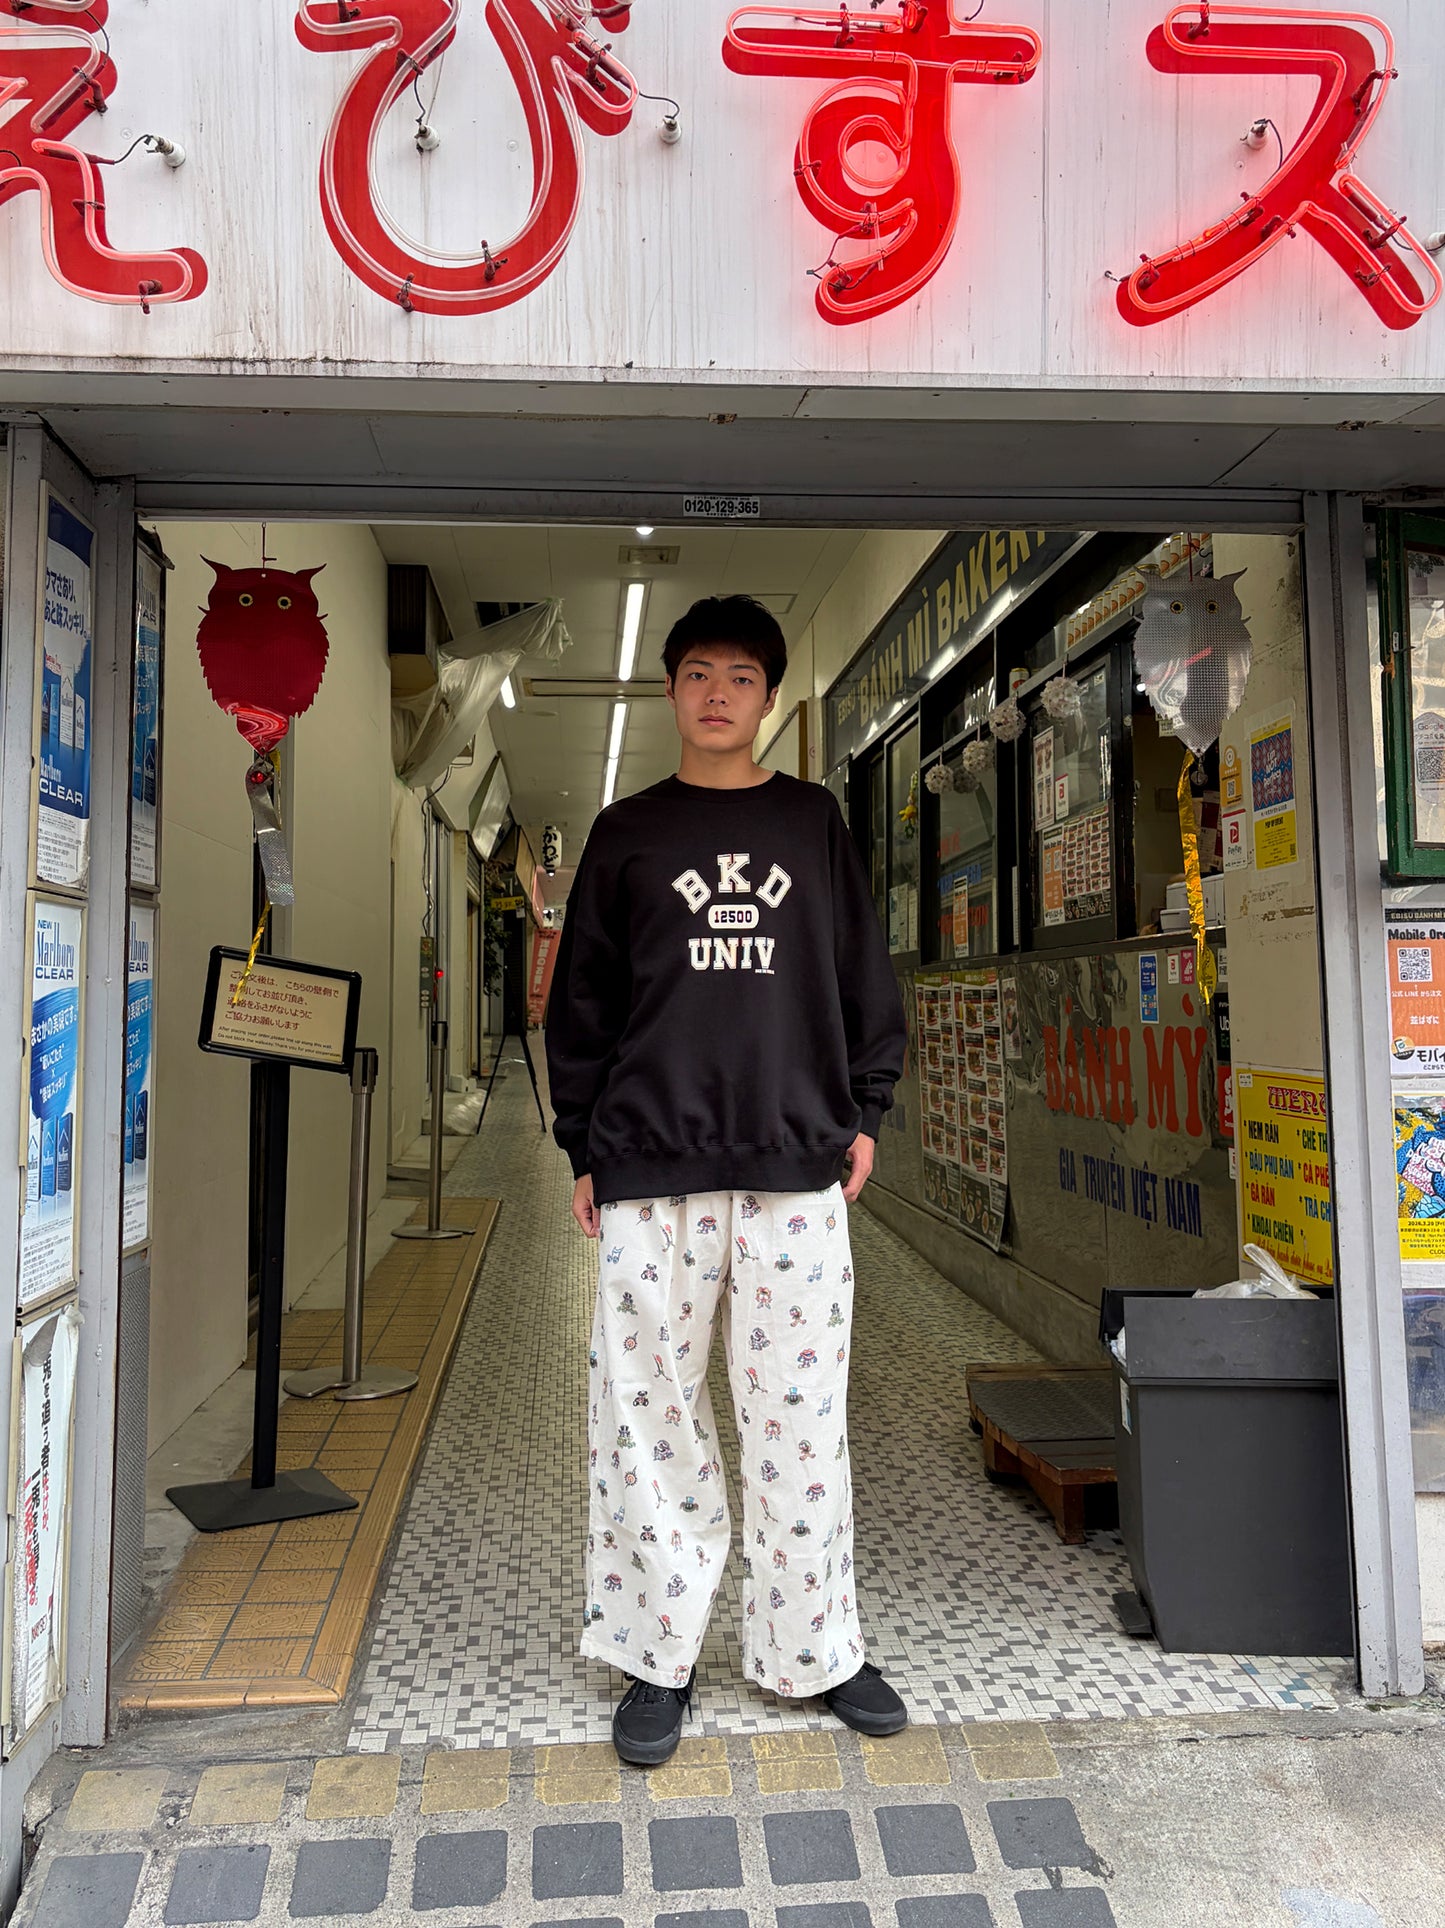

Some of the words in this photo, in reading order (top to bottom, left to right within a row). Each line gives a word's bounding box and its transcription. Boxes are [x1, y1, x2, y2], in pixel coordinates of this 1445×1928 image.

[684, 499, 759, 514] 0120-129-365
[859, 632, 903, 727] BÁNH
[936, 530, 1046, 649] BAKER
[1418, 723, 1444, 731] Google
[39, 777, 83, 807] CLEAR
[671, 853, 792, 914] BKD
[37, 919, 52, 929] NEW
[714, 910, 752, 923] 12500
[36, 922, 75, 968] Marlboro
[1388, 928, 1426, 940] Mobile
[688, 936, 775, 973] UNIV
[35, 967, 74, 980] CLEAR
[230, 970, 278, 987] ご文後は、
[225, 1011, 300, 1031] ご協力お願いします
[1042, 996, 1135, 1126] BÁNH
[1248, 1119, 1263, 1141] NEM
[1059, 1147, 1077, 1194] GIA
[1130, 1161, 1158, 1230] VIỆT
[1164, 1176, 1203, 1238] NAM
[1251, 1218, 1271, 1240] KHOAI
